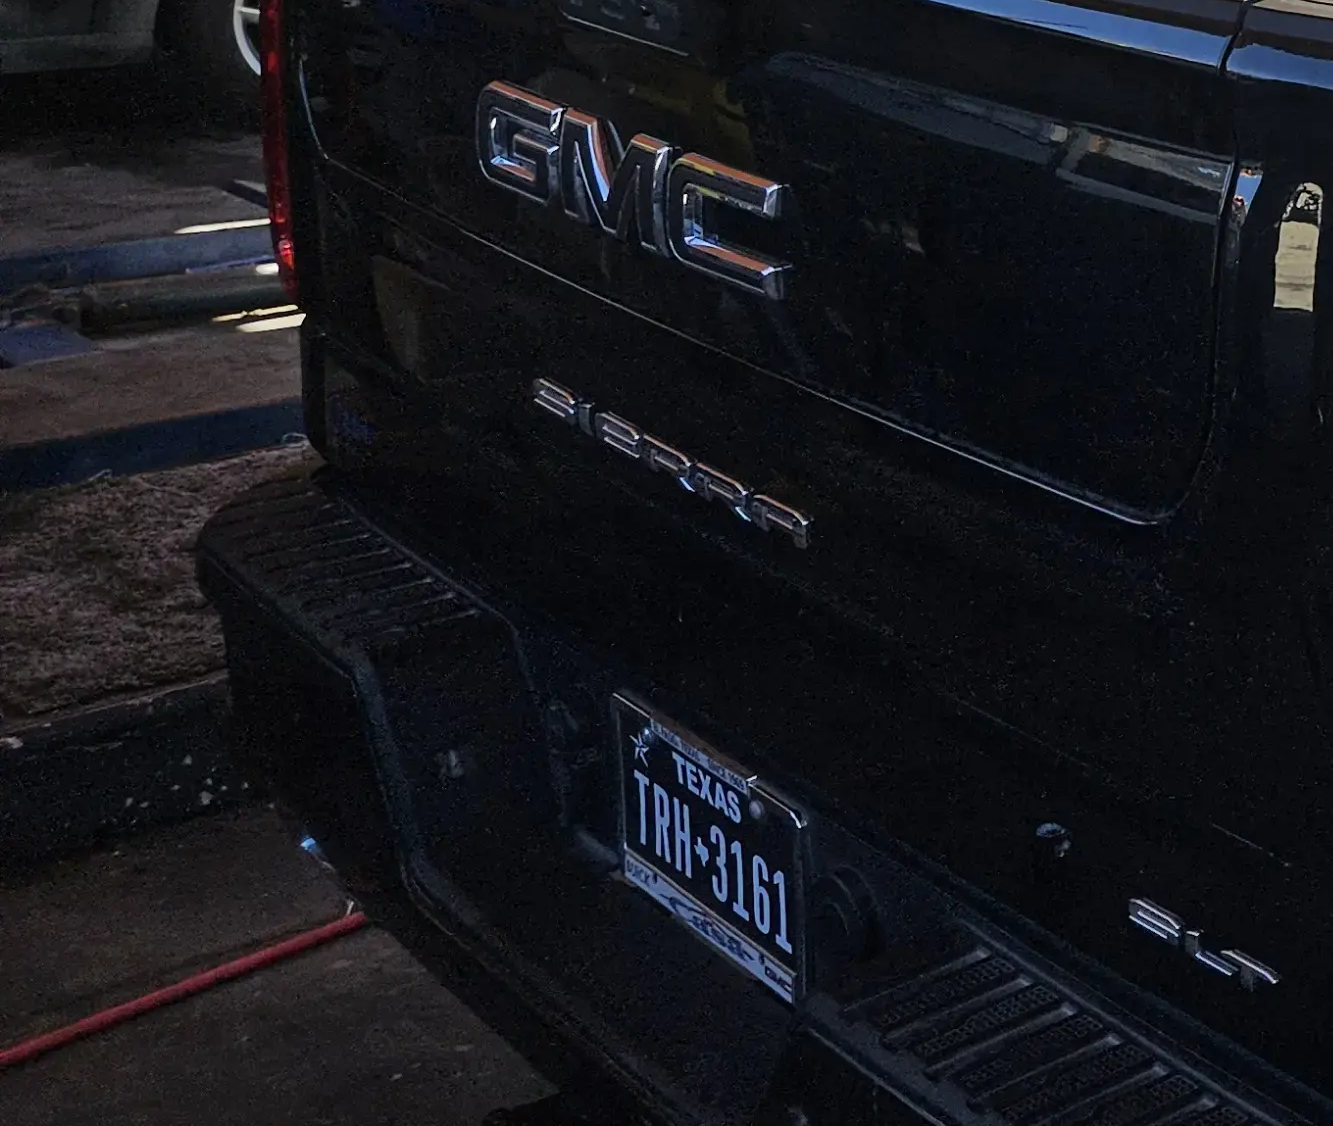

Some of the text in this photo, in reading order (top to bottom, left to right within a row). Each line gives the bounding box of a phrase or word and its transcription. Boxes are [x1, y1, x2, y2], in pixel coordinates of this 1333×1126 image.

[476, 79, 793, 301] GMC
[532, 376, 813, 550] SIERRA
[672, 751, 741, 824] TEXAS
